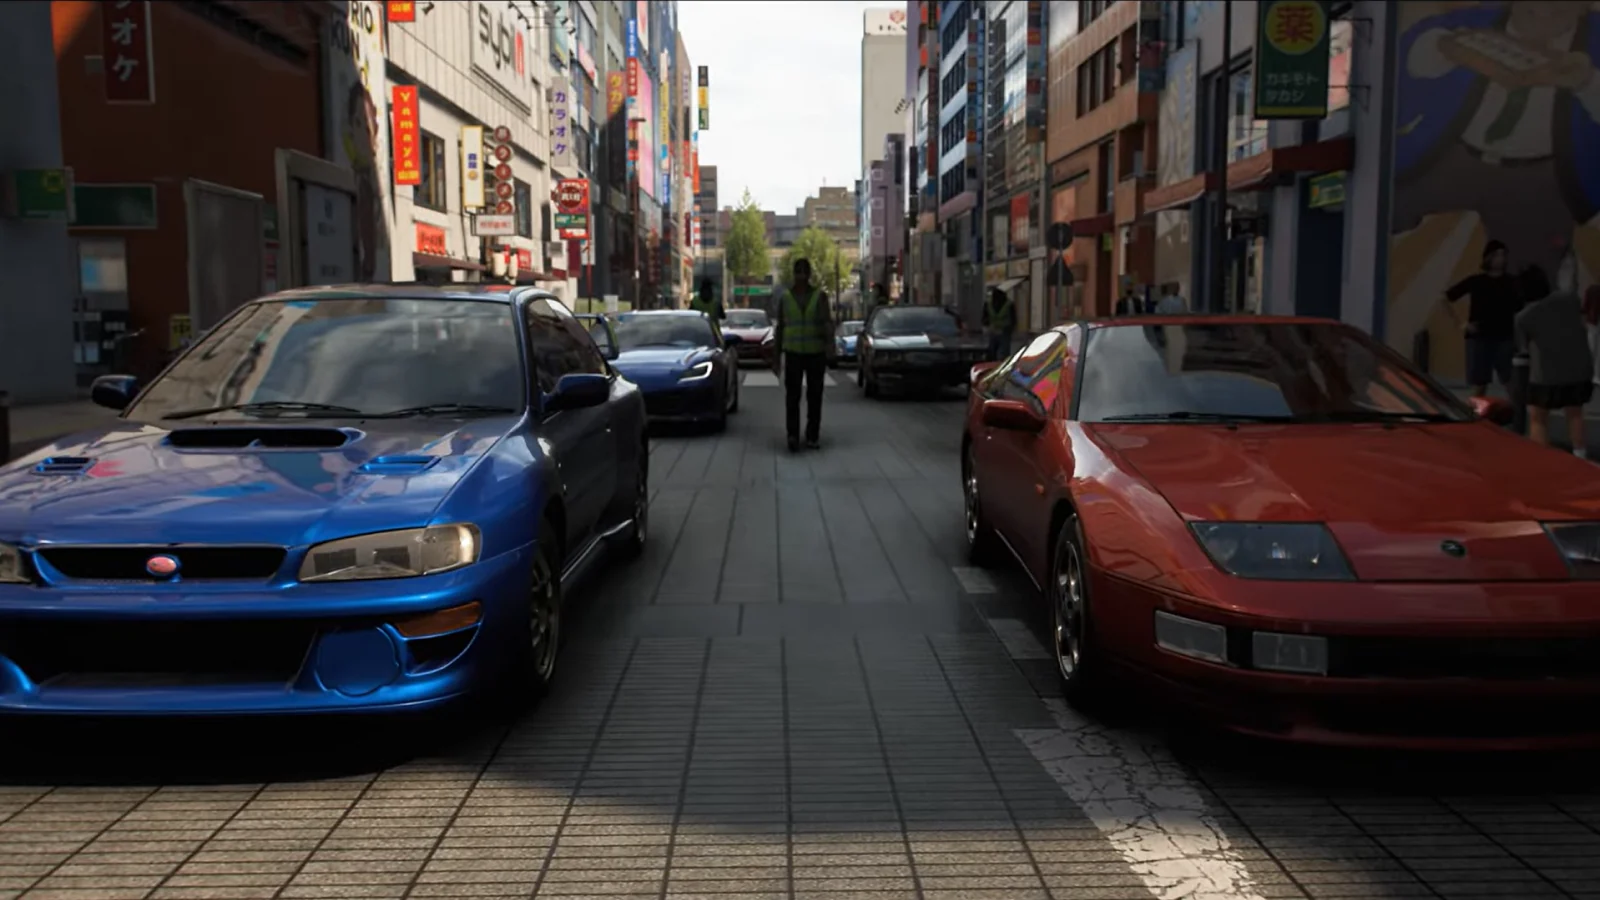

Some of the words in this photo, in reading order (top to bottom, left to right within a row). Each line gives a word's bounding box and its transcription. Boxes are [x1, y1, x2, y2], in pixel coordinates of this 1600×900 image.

[1274, 5, 1315, 44] 薬
[555, 91, 567, 155] カラオケ
